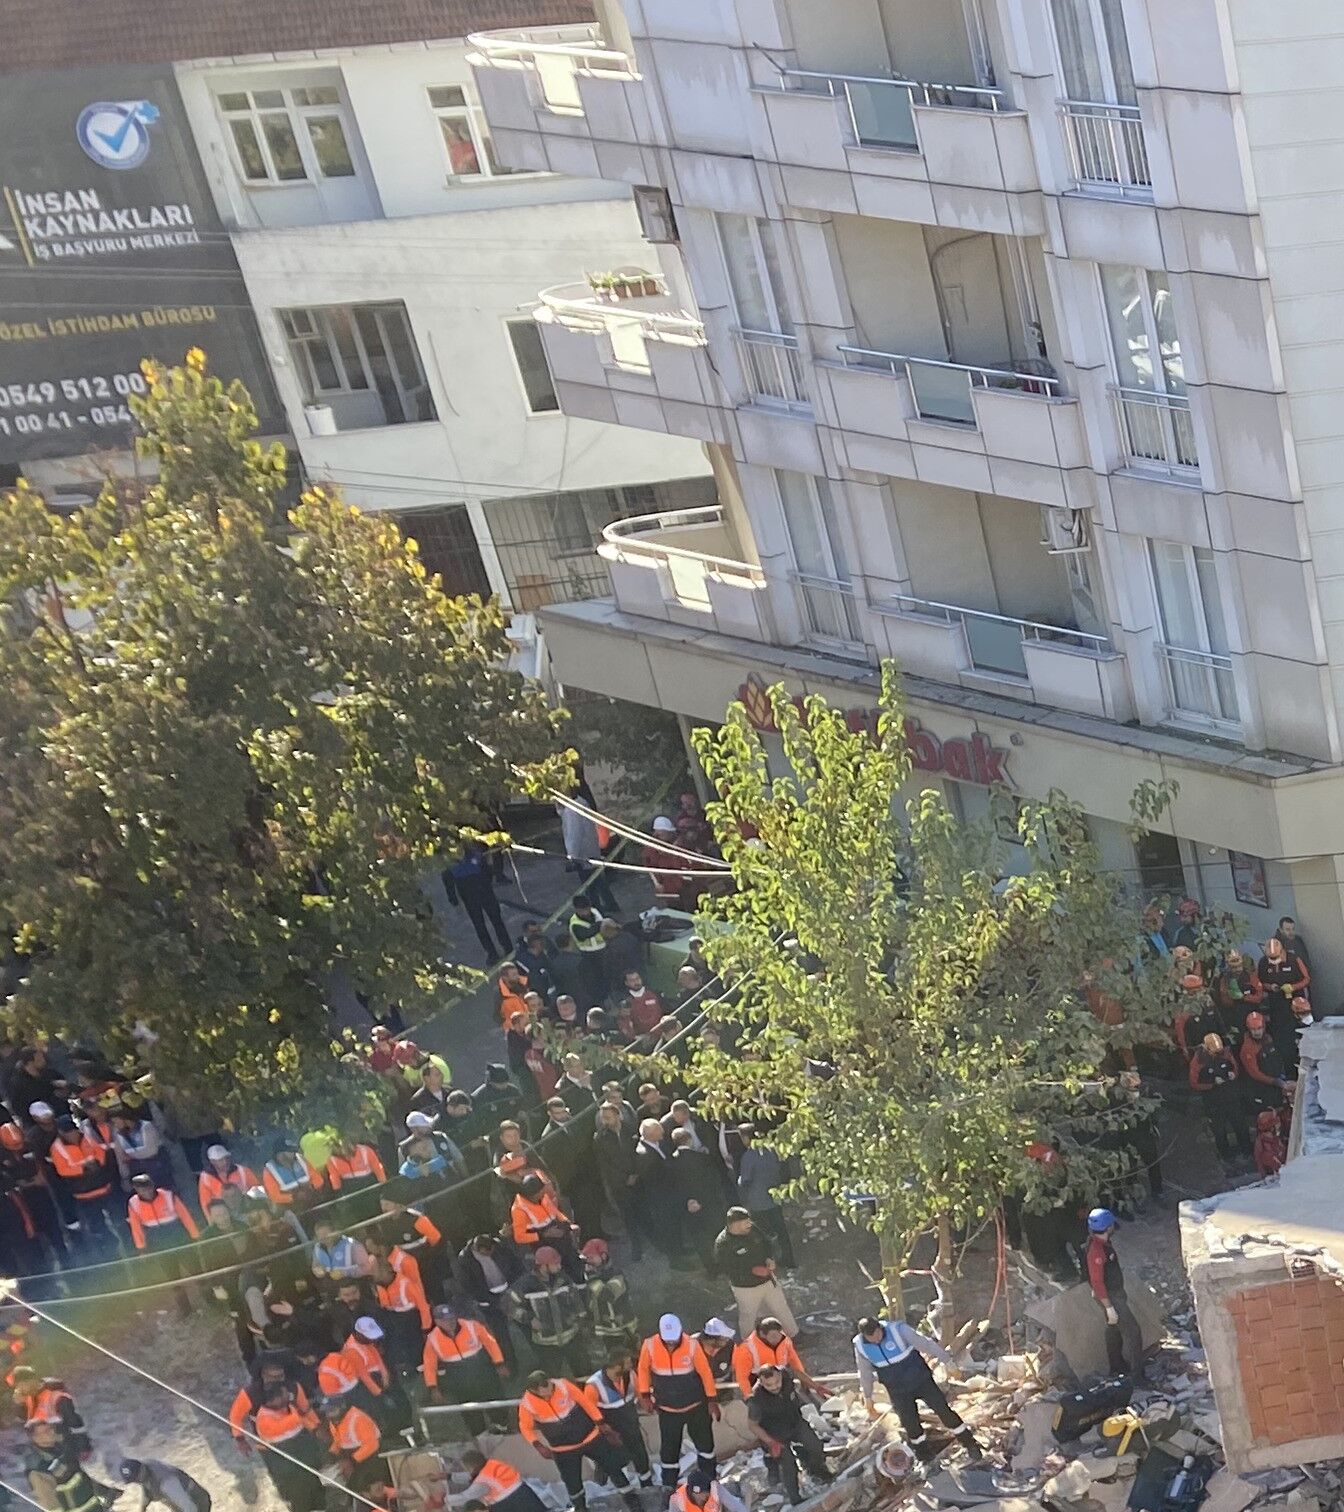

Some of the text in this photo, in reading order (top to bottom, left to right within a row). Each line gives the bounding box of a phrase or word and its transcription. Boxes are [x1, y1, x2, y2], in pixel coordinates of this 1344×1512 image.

[15, 187, 101, 216] İNSAN
[24, 204, 194, 239] KAYNAKLARI
[33, 228, 200, 259] İŞ BAŞVURU MERKEZİ
[0, 321, 48, 340] ÖZEL
[140, 304, 216, 327] BÜROSU
[61, 376, 110, 400] 512
[15, 414, 43, 433] 00
[47, 410, 72, 430] 41
